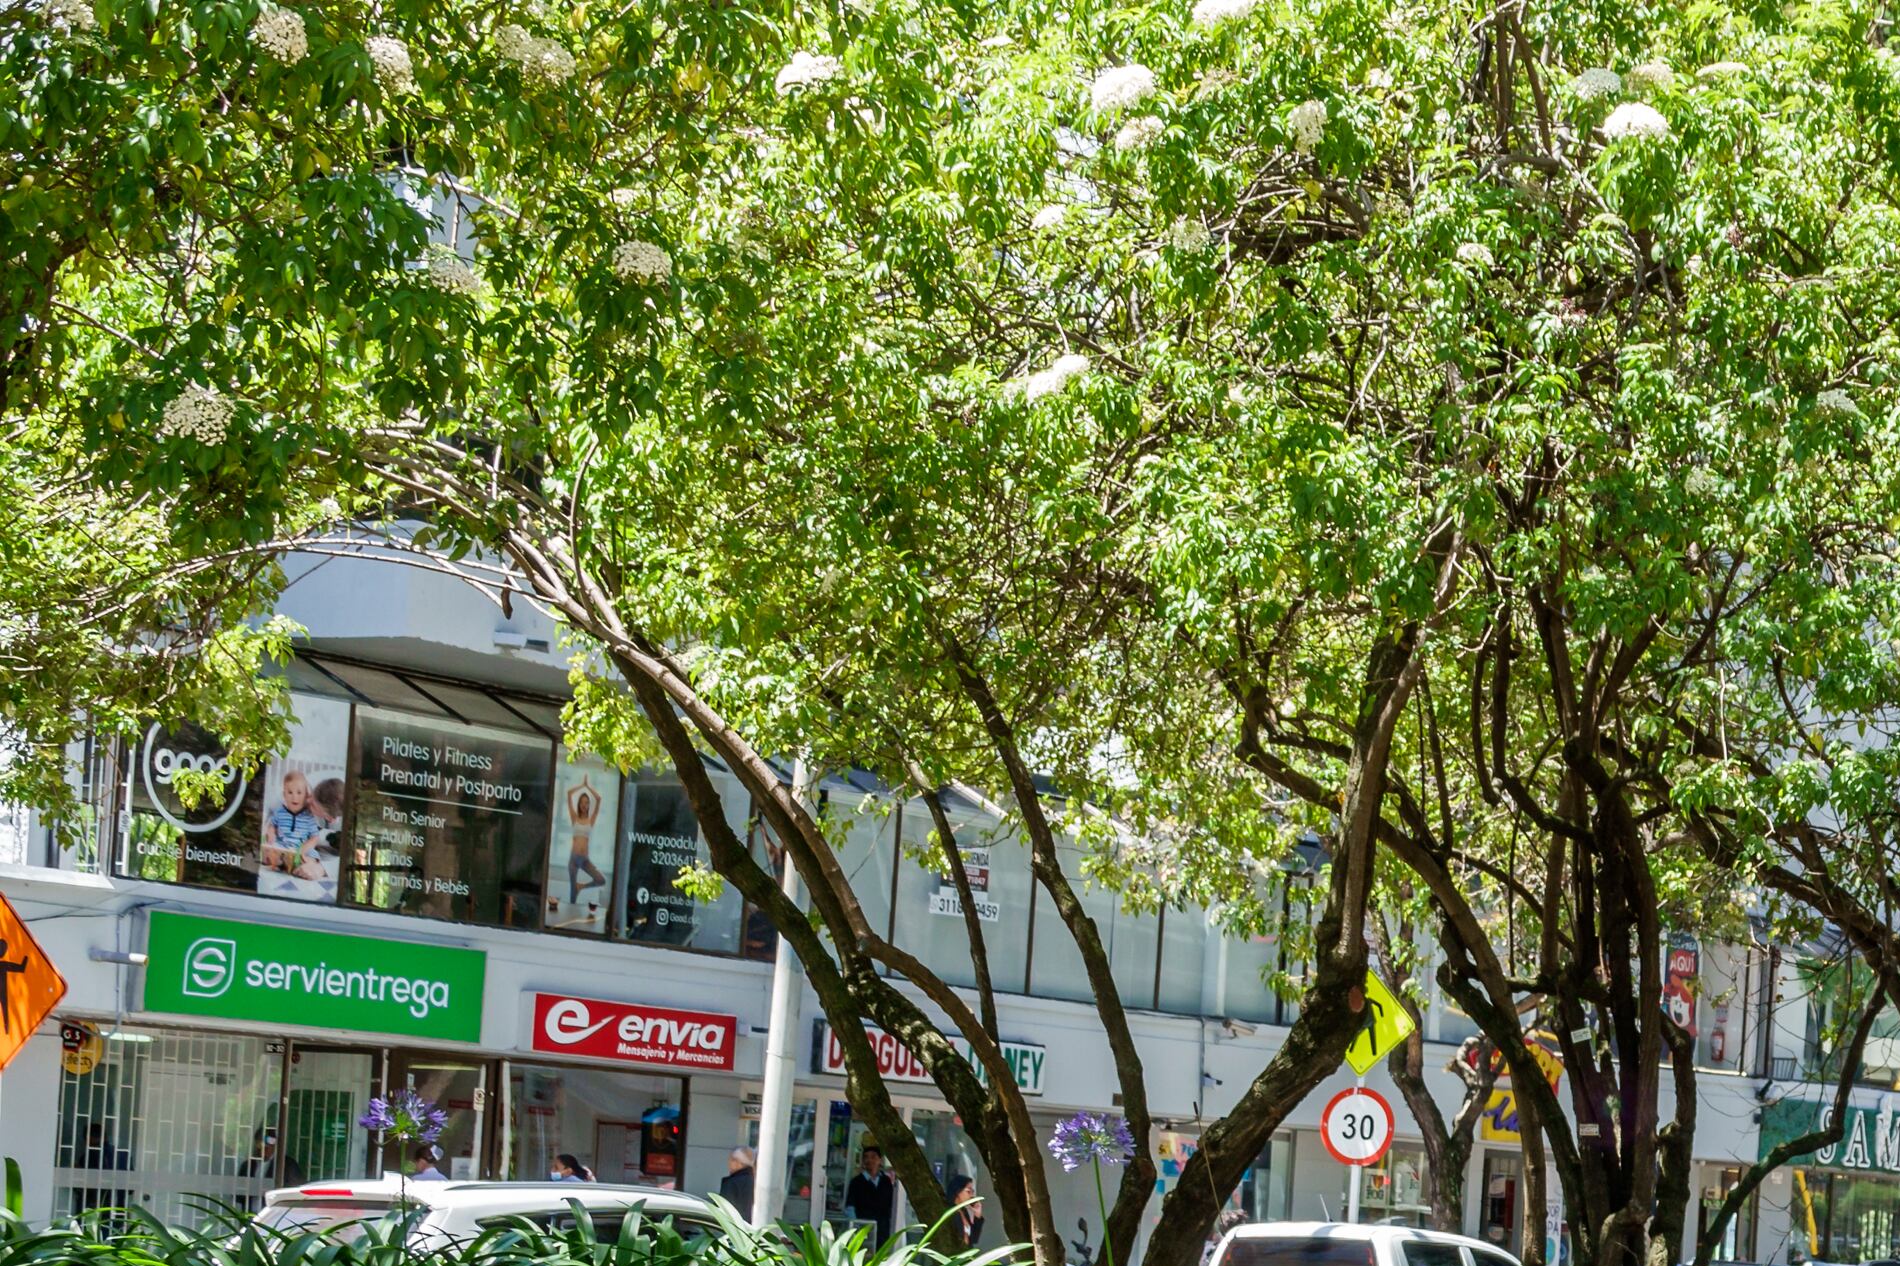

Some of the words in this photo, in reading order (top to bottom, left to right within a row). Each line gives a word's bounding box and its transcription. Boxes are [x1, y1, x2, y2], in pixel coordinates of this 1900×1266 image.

[383, 736, 430, 761] Pilates
[433, 748, 442, 767] y
[445, 746, 493, 771] Fitness
[381, 764, 440, 790] Prenatal
[445, 777, 453, 796] y
[456, 776, 523, 802] Postparto
[383, 806, 407, 825] Plan
[411, 811, 446, 829] Senior
[628, 831, 698, 851] www.goodclu
[185, 845, 244, 867] bienestar
[387, 873, 422, 890] amás
[425, 879, 433, 894] y
[434, 877, 470, 896] Bebés
[938, 898, 998, 918] 3118459
[246, 959, 449, 1018] servientrega
[668, 1051, 675, 1062] y
[1342, 1114, 1375, 1141] 30
